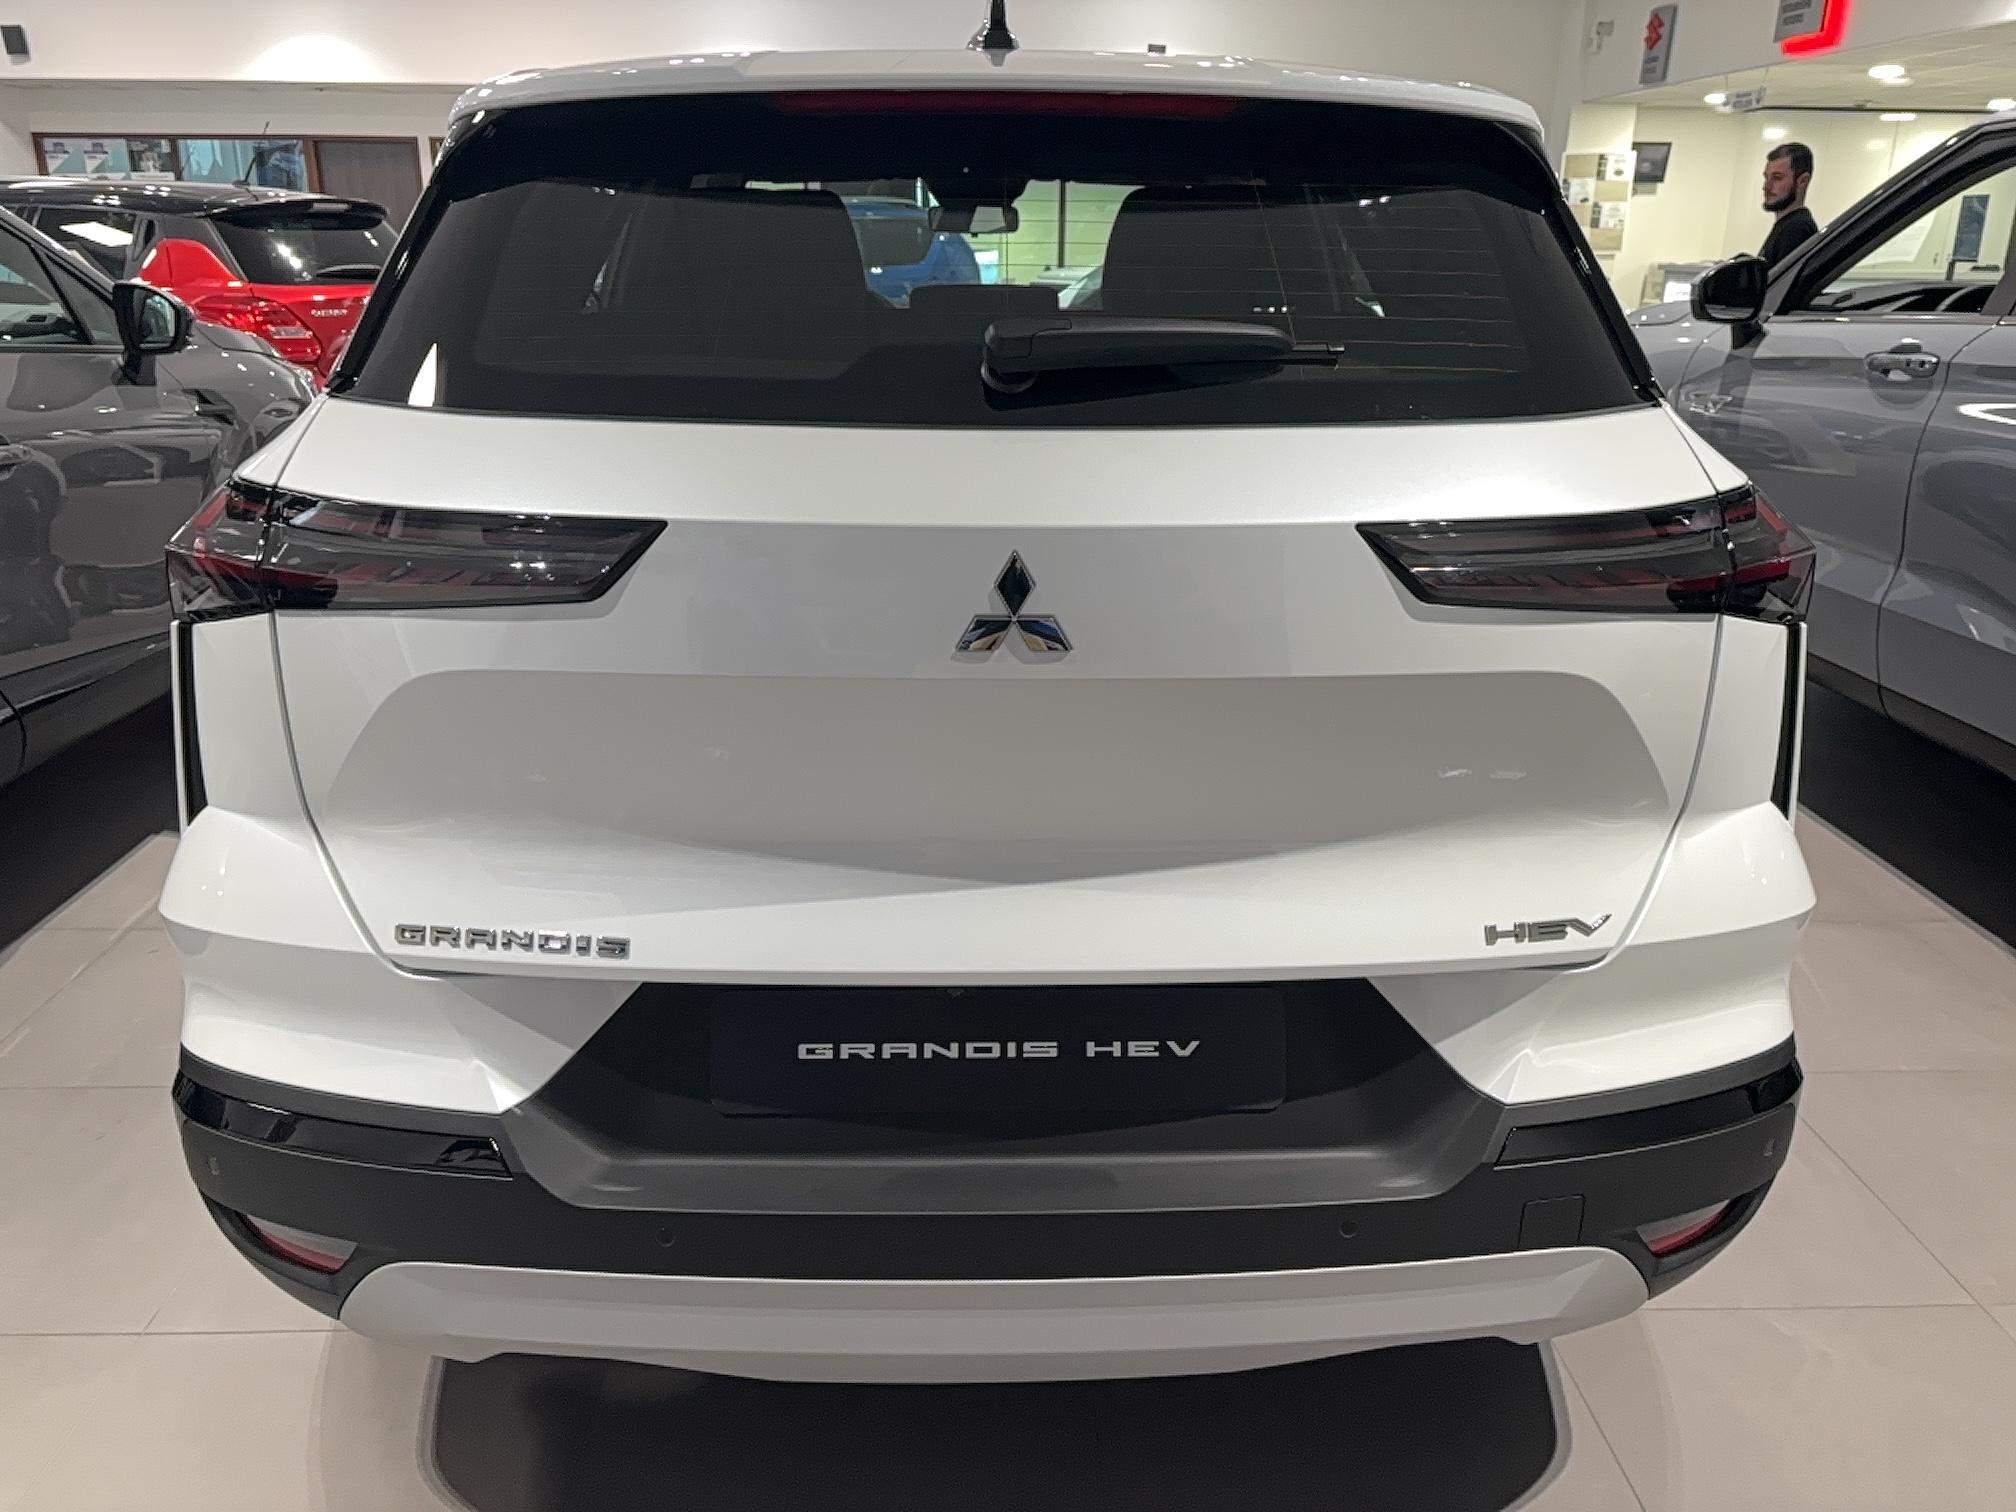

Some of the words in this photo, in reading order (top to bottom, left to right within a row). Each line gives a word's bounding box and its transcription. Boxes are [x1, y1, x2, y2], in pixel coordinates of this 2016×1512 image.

[395, 922, 630, 959] GRANDIS
[1484, 914, 1611, 946] HEV
[797, 1041, 1059, 1060] GRANDIS
[1085, 1040, 1201, 1058] HEV
